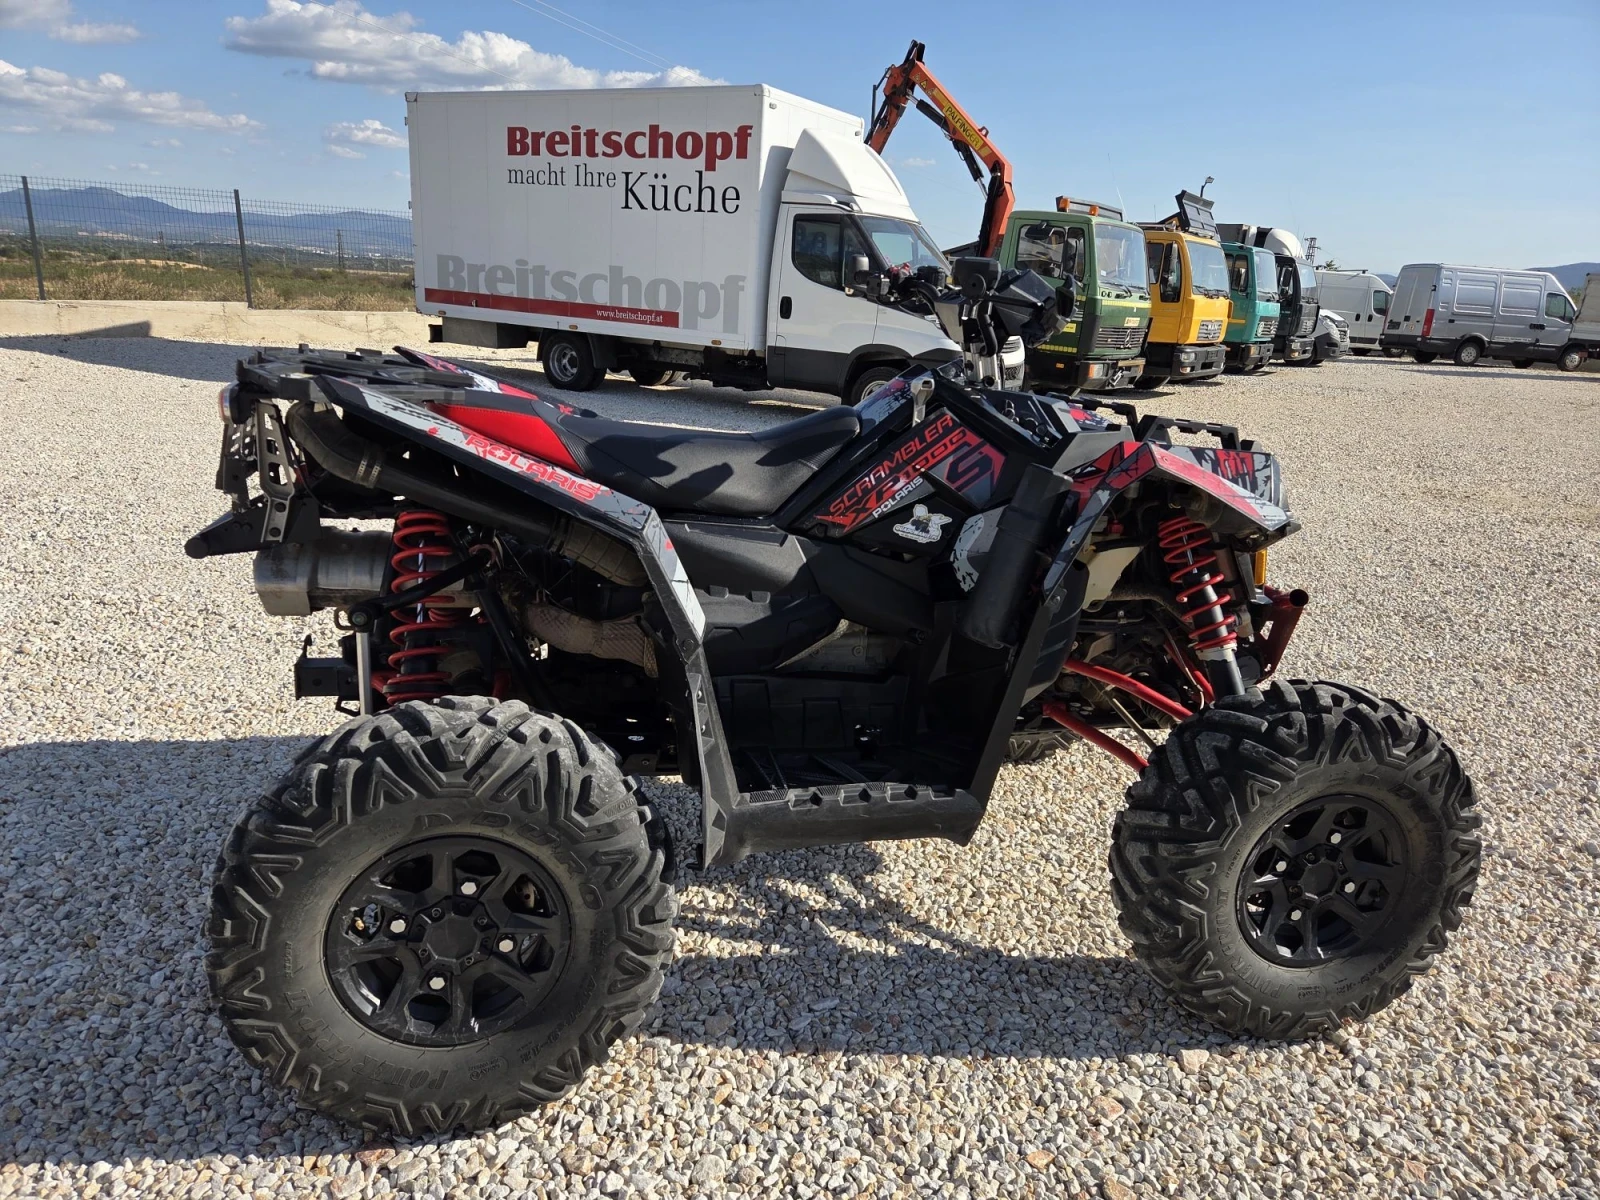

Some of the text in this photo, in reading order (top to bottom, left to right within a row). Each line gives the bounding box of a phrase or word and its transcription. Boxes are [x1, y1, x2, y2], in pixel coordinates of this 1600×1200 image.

[507, 124, 753, 171] Breitschopf
[946, 106, 980, 147] PALFINGER
[507, 162, 617, 188] macht Ihre
[621, 170, 741, 214] Küche
[436, 254, 747, 334] Breitschopf
[596, 309, 663, 323] www.breitschopf.at
[465, 434, 602, 501] POLARIS
[829, 414, 953, 514] SCRAMBLER
[872, 475, 924, 519] POLARIS
